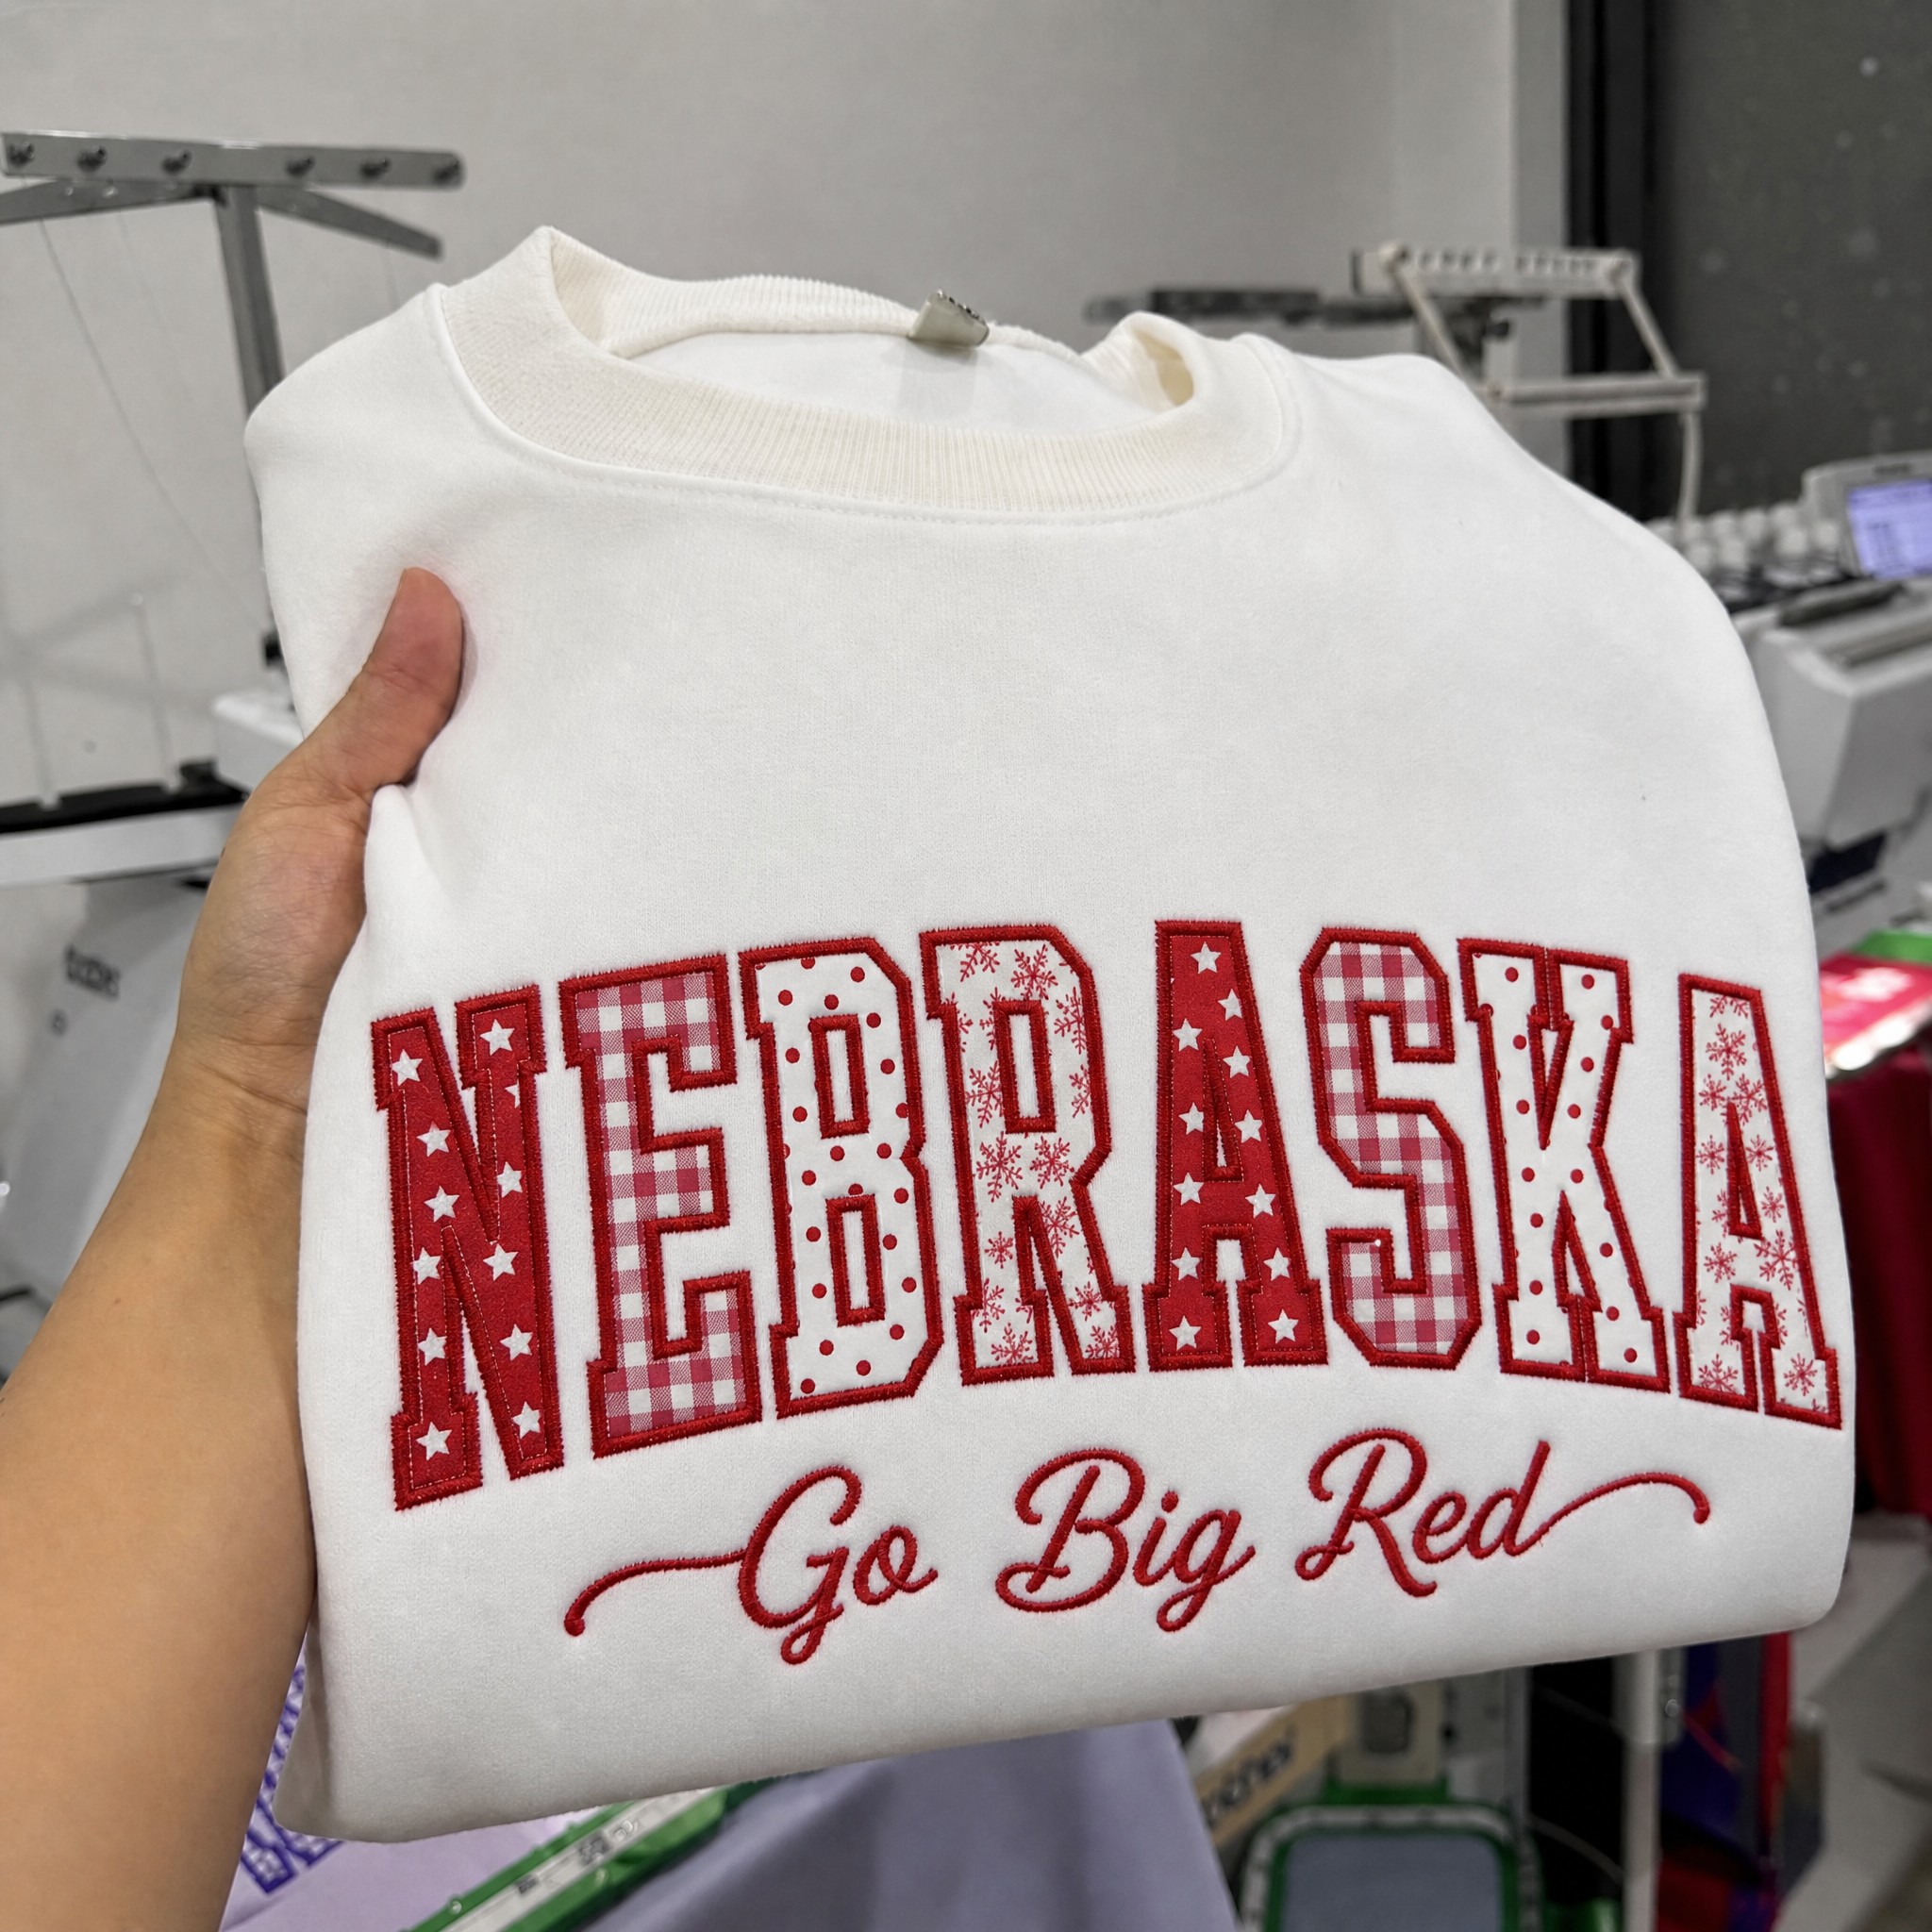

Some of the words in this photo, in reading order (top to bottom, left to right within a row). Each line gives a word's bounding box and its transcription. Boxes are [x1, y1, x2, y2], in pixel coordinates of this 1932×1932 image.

[371, 920, 1842, 1510] NEBRASKA
[564, 1465, 938, 1666] Go
[995, 1448, 1256, 1633] Big
[1295, 1426, 1711, 1598] Red
